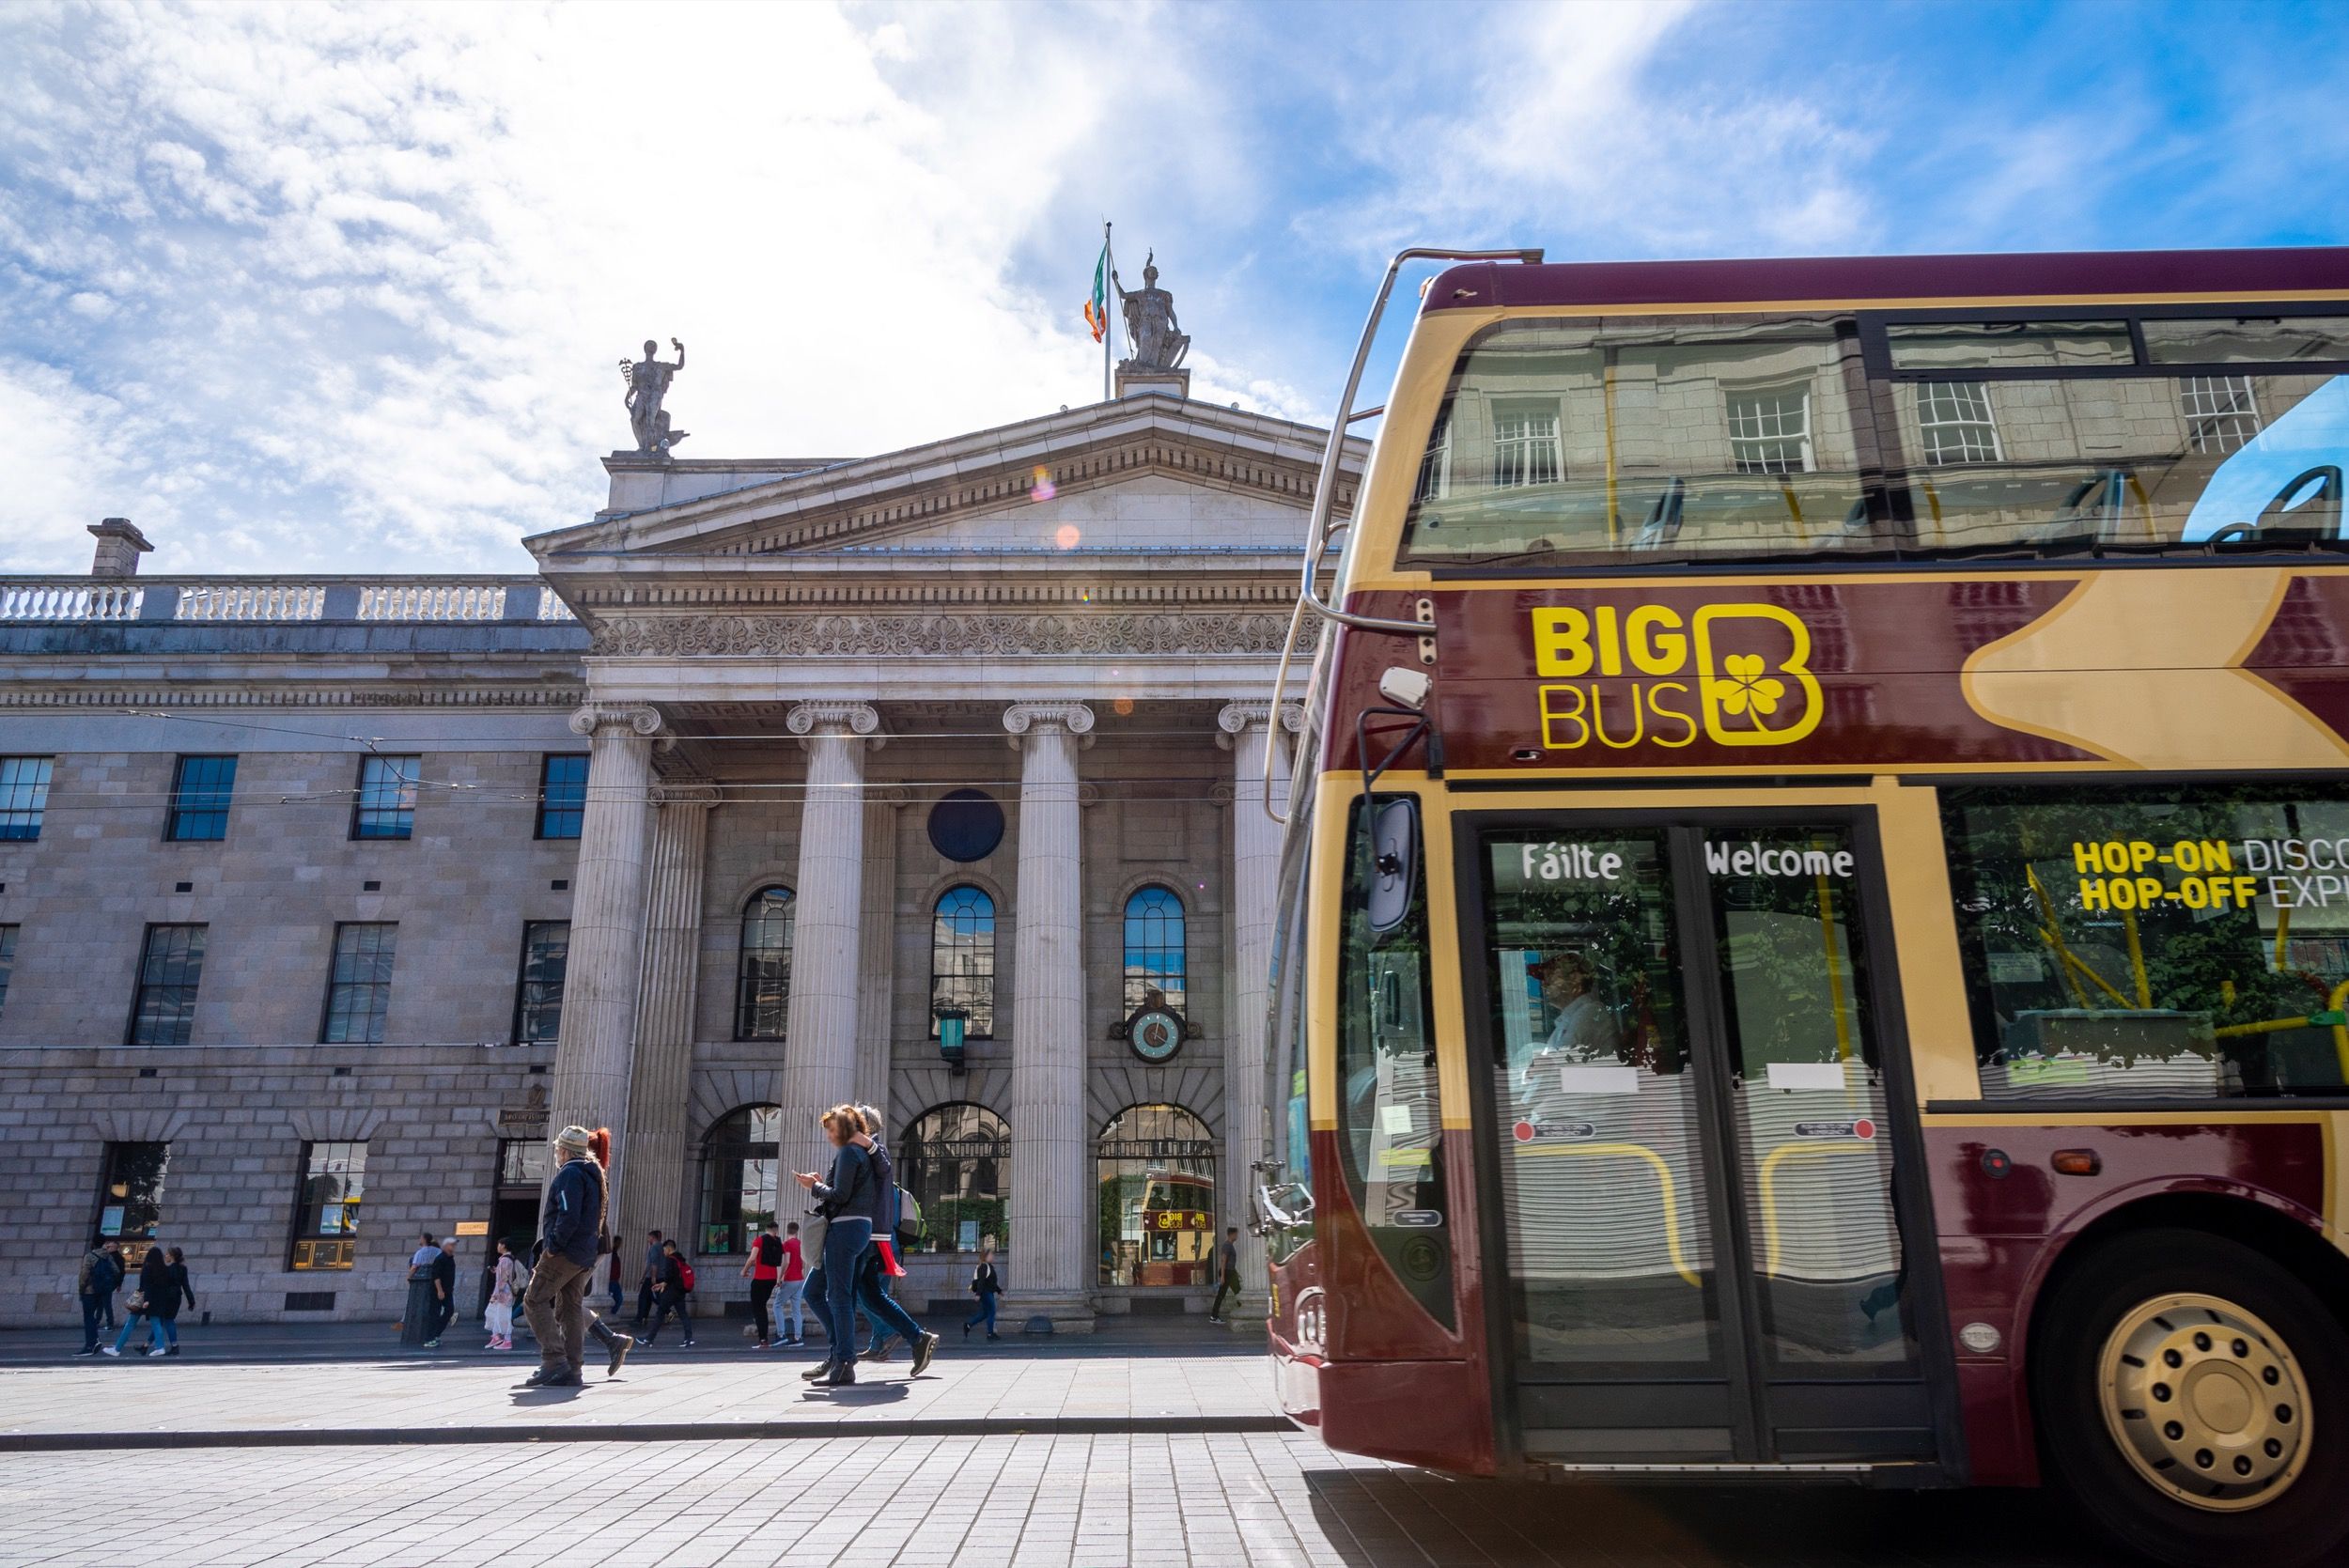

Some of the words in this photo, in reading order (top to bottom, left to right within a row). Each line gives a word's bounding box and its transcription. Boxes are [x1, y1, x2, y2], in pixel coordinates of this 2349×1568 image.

[1532, 605, 1688, 676] BIG
[1538, 682, 1698, 749] BUS
[1522, 841, 1623, 880] Fáilte
[1704, 841, 1855, 877] Welcome
[2073, 840, 2233, 874] HOP-ON
[2079, 876, 2257, 910] HOP-OFF
